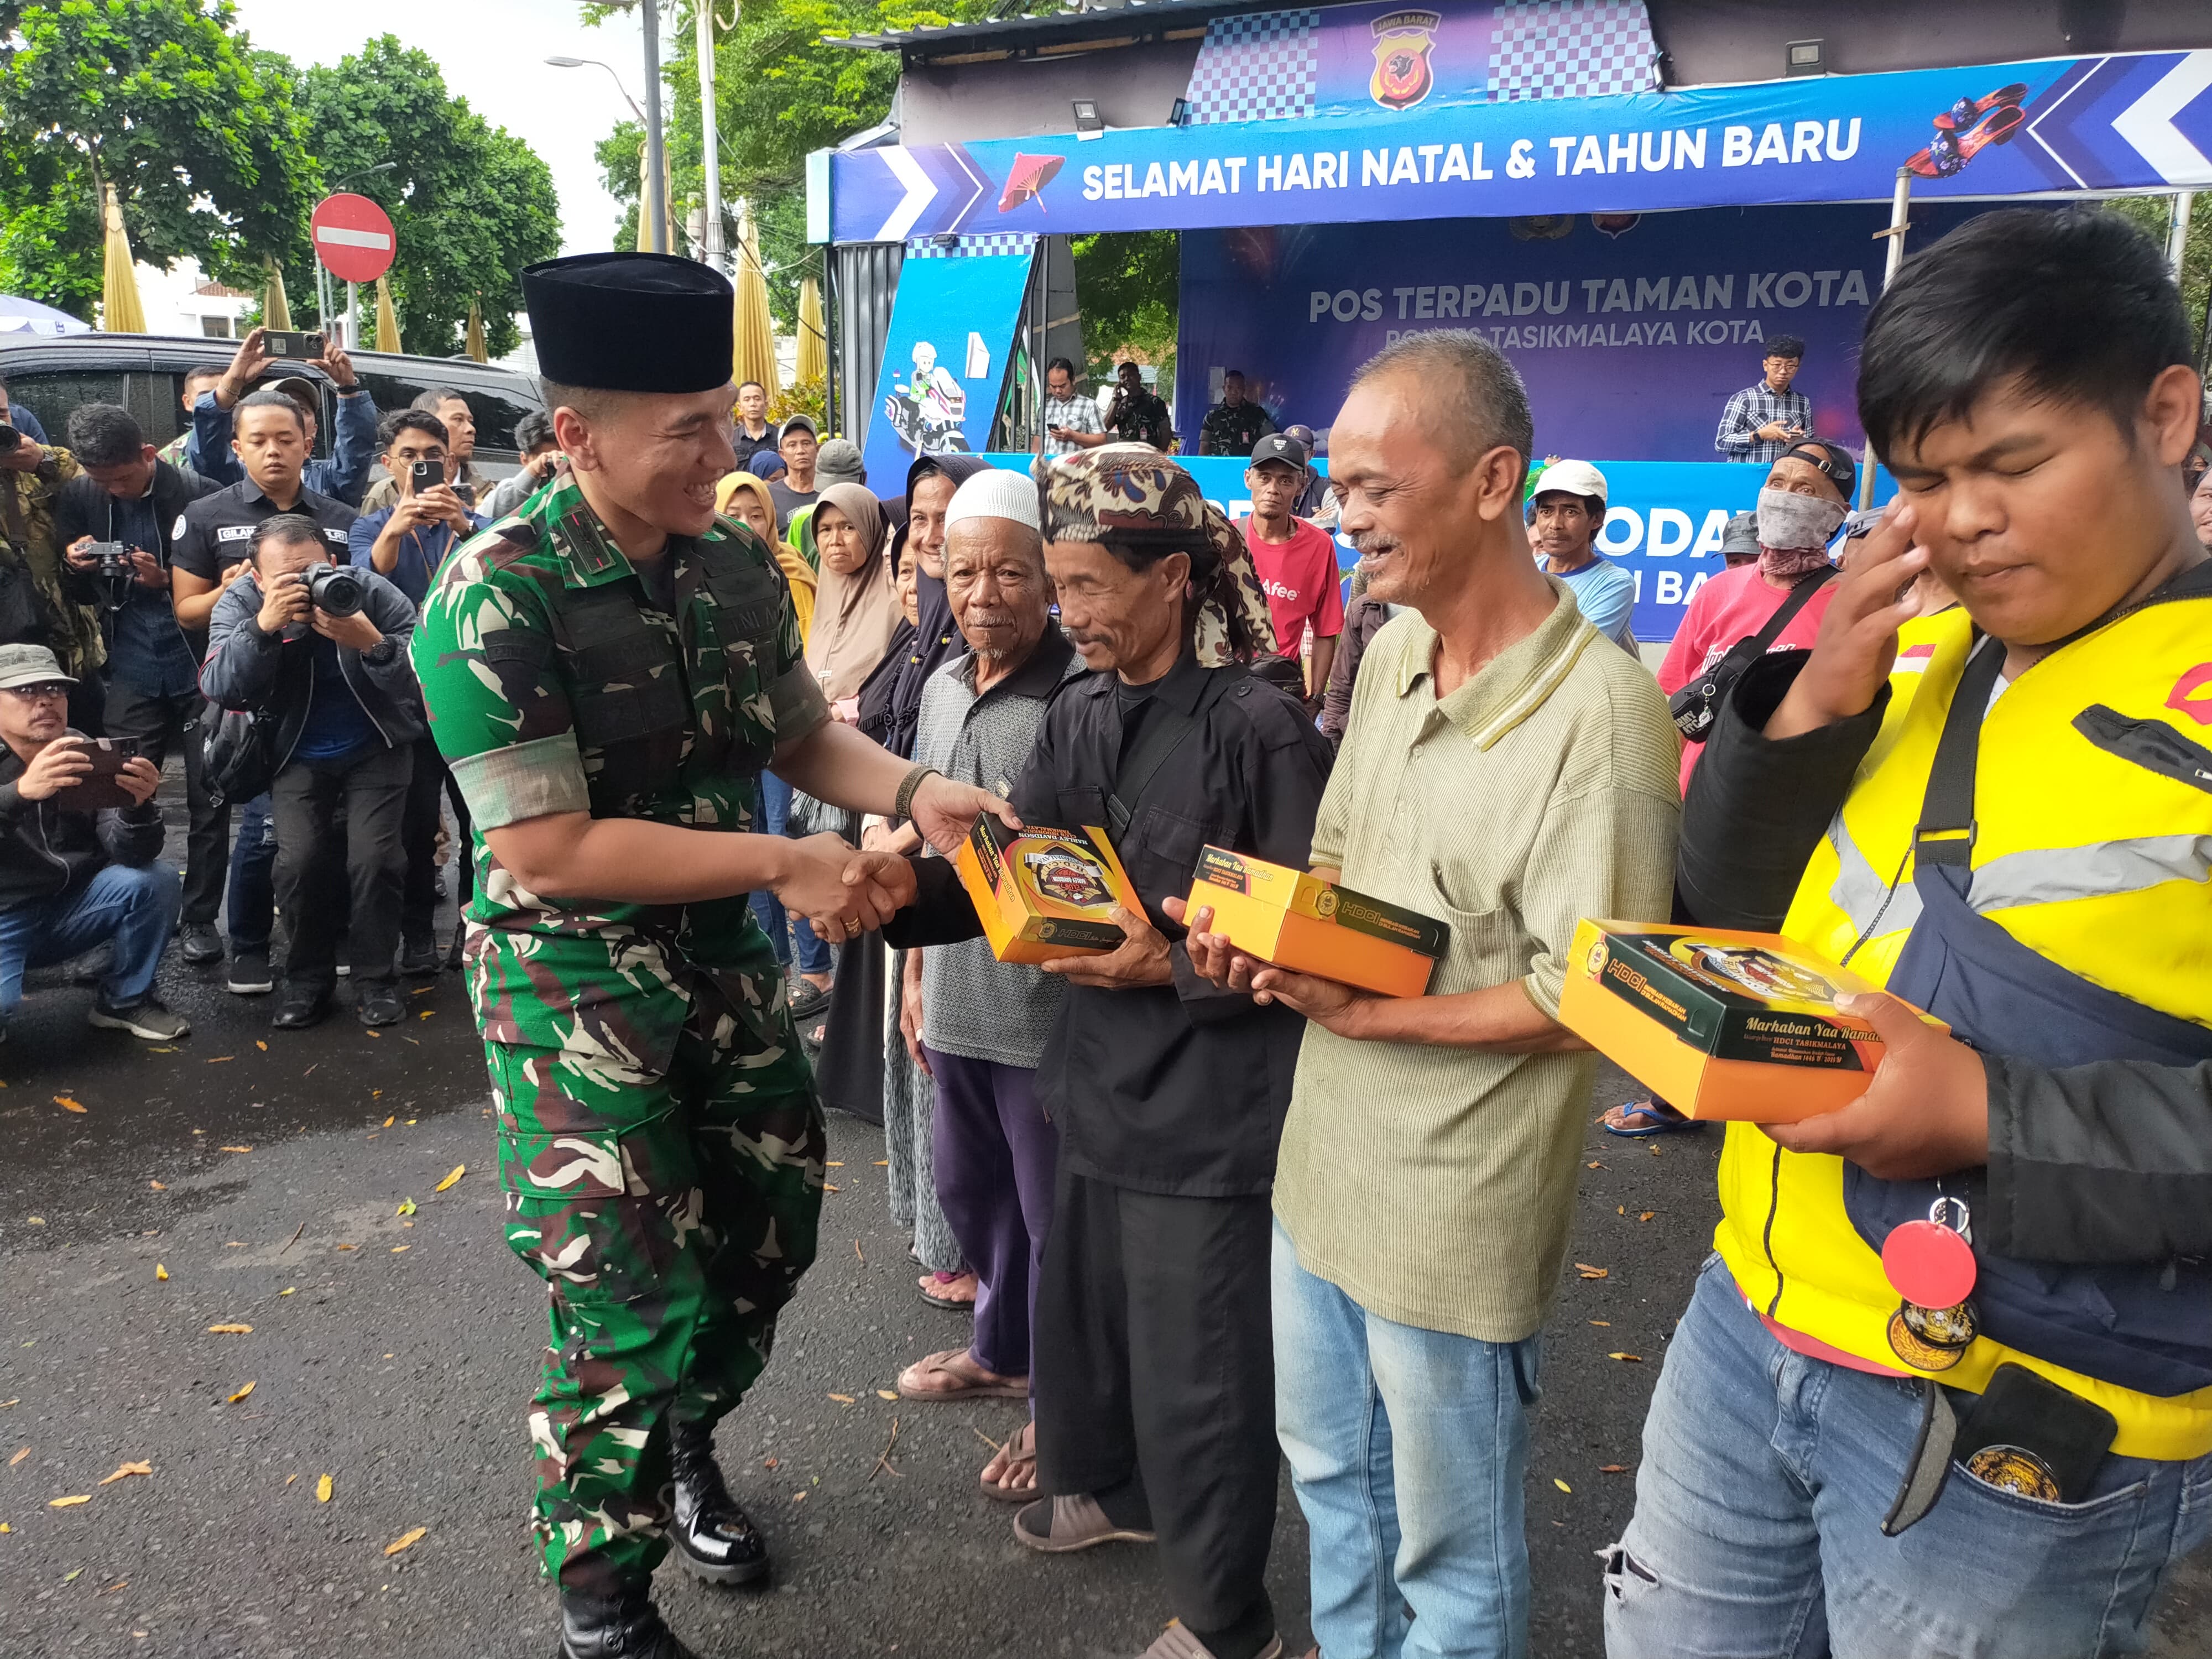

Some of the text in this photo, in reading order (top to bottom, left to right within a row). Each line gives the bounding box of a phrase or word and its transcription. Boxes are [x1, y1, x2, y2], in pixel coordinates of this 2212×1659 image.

[1378, 15, 1435, 32] JAWA BARAT
[1082, 117, 1861, 201] SELAMAT HARI NATAL & TAHUN BARU
[1310, 269, 1870, 322] POS TERPADU TAMAN KOTA
[1490, 322, 1678, 349] TASIKMALAYA
[1687, 319, 1765, 345] KOTA
[1059, 836, 1088, 845] HARLEY
[979, 825, 994, 857] Marhaban
[998, 867, 1015, 902] Ramadhan
[1206, 853, 1233, 869] Marhaban
[1232, 861, 1244, 872] Yaa
[1242, 864, 1274, 881] Ramadhan
[1342, 901, 1381, 924] HDCI
[1058, 929, 1092, 940] HDCI
[1607, 958, 1647, 992] HDCI
[1745, 1017, 1811, 1036] Marhaban
[1814, 1024, 1838, 1039] Yaa
[1773, 1036, 1794, 1046] HDCI
[1795, 1039, 1846, 1051] TASIKMALAYA
